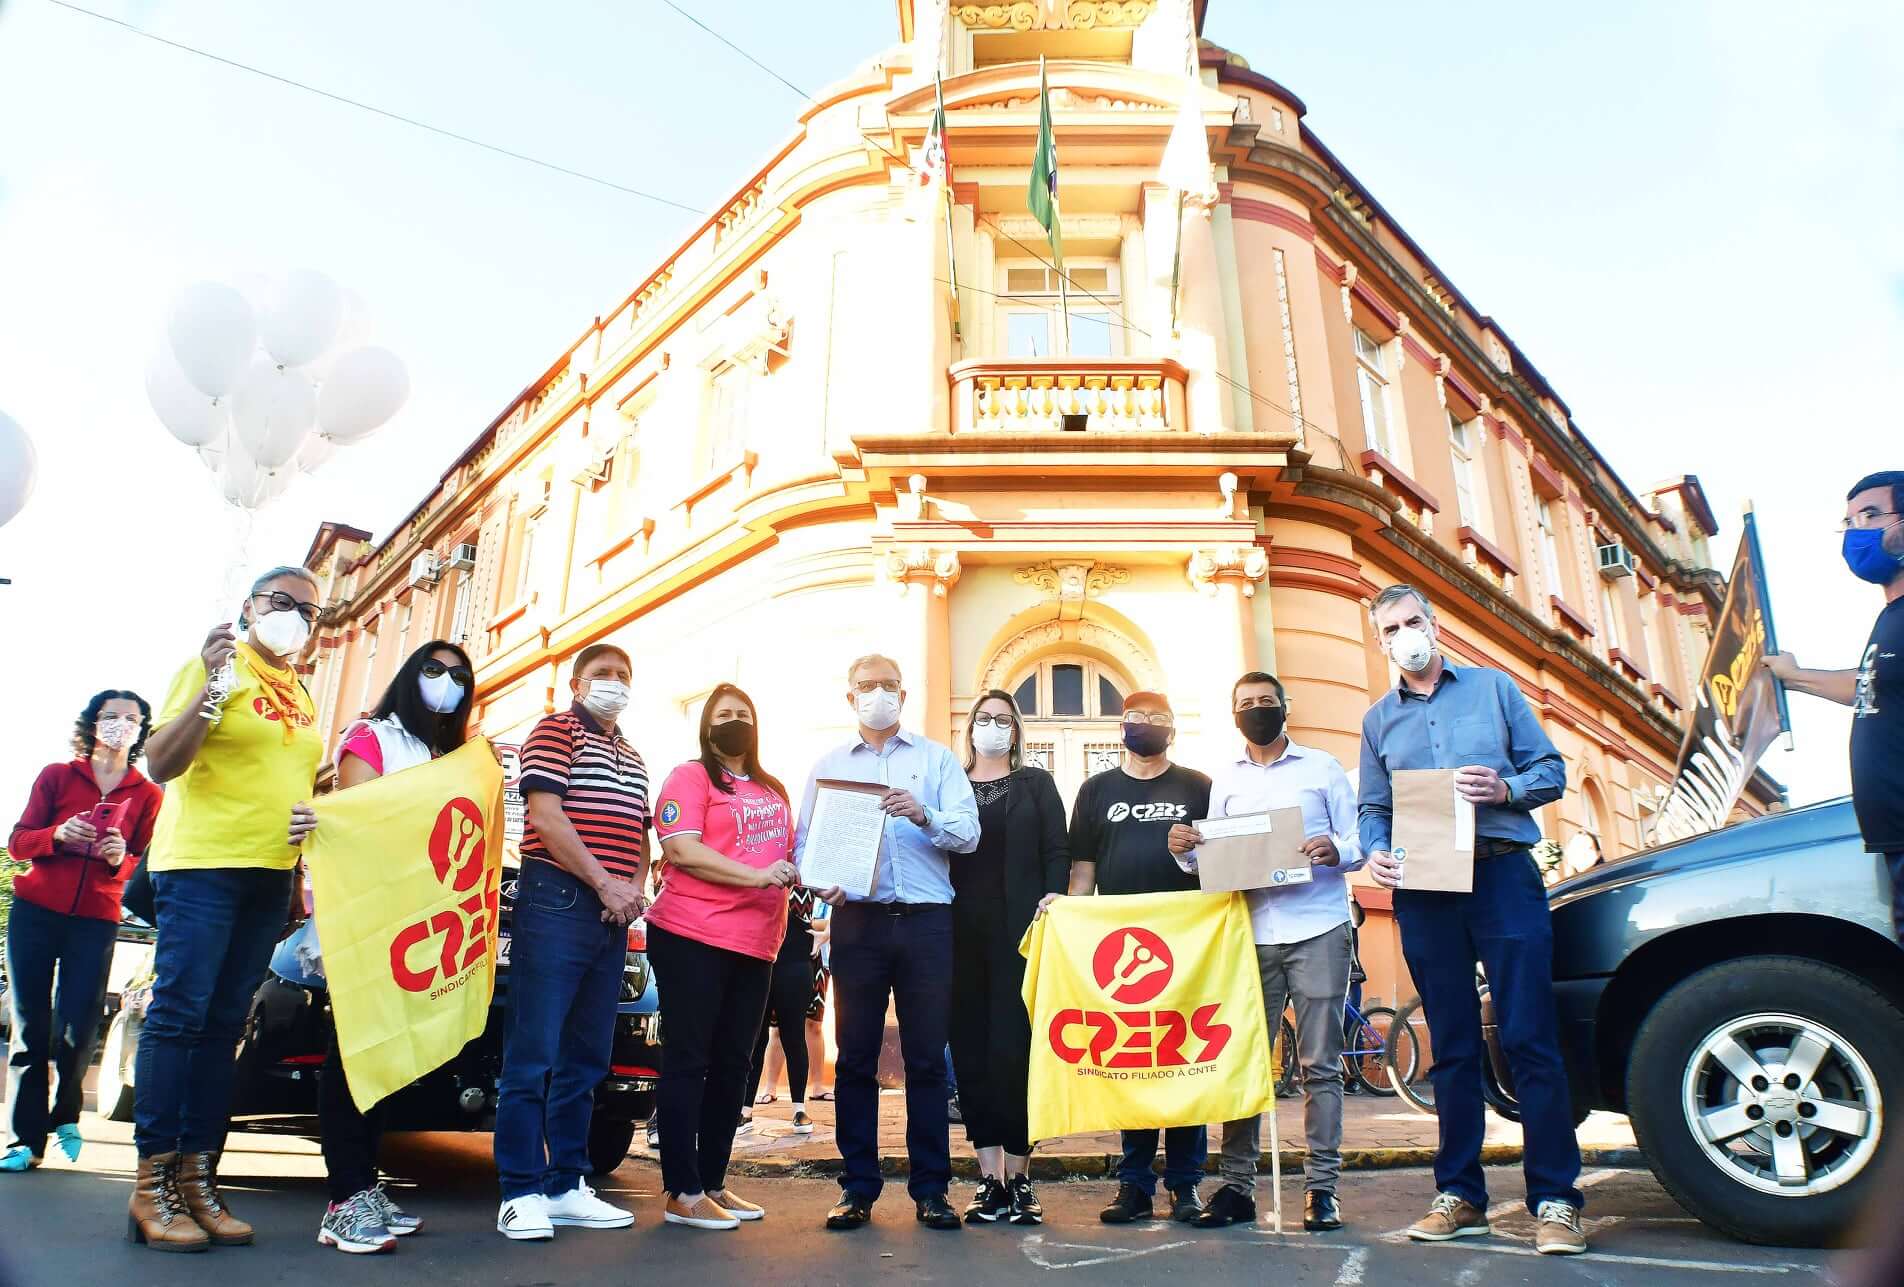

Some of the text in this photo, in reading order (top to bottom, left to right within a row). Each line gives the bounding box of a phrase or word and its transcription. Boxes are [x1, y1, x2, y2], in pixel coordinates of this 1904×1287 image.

[1077, 1067, 1128, 1080] SINDICATO
[1131, 1070, 1175, 1080] FILIADO
[1188, 1064, 1217, 1076] CNTE
